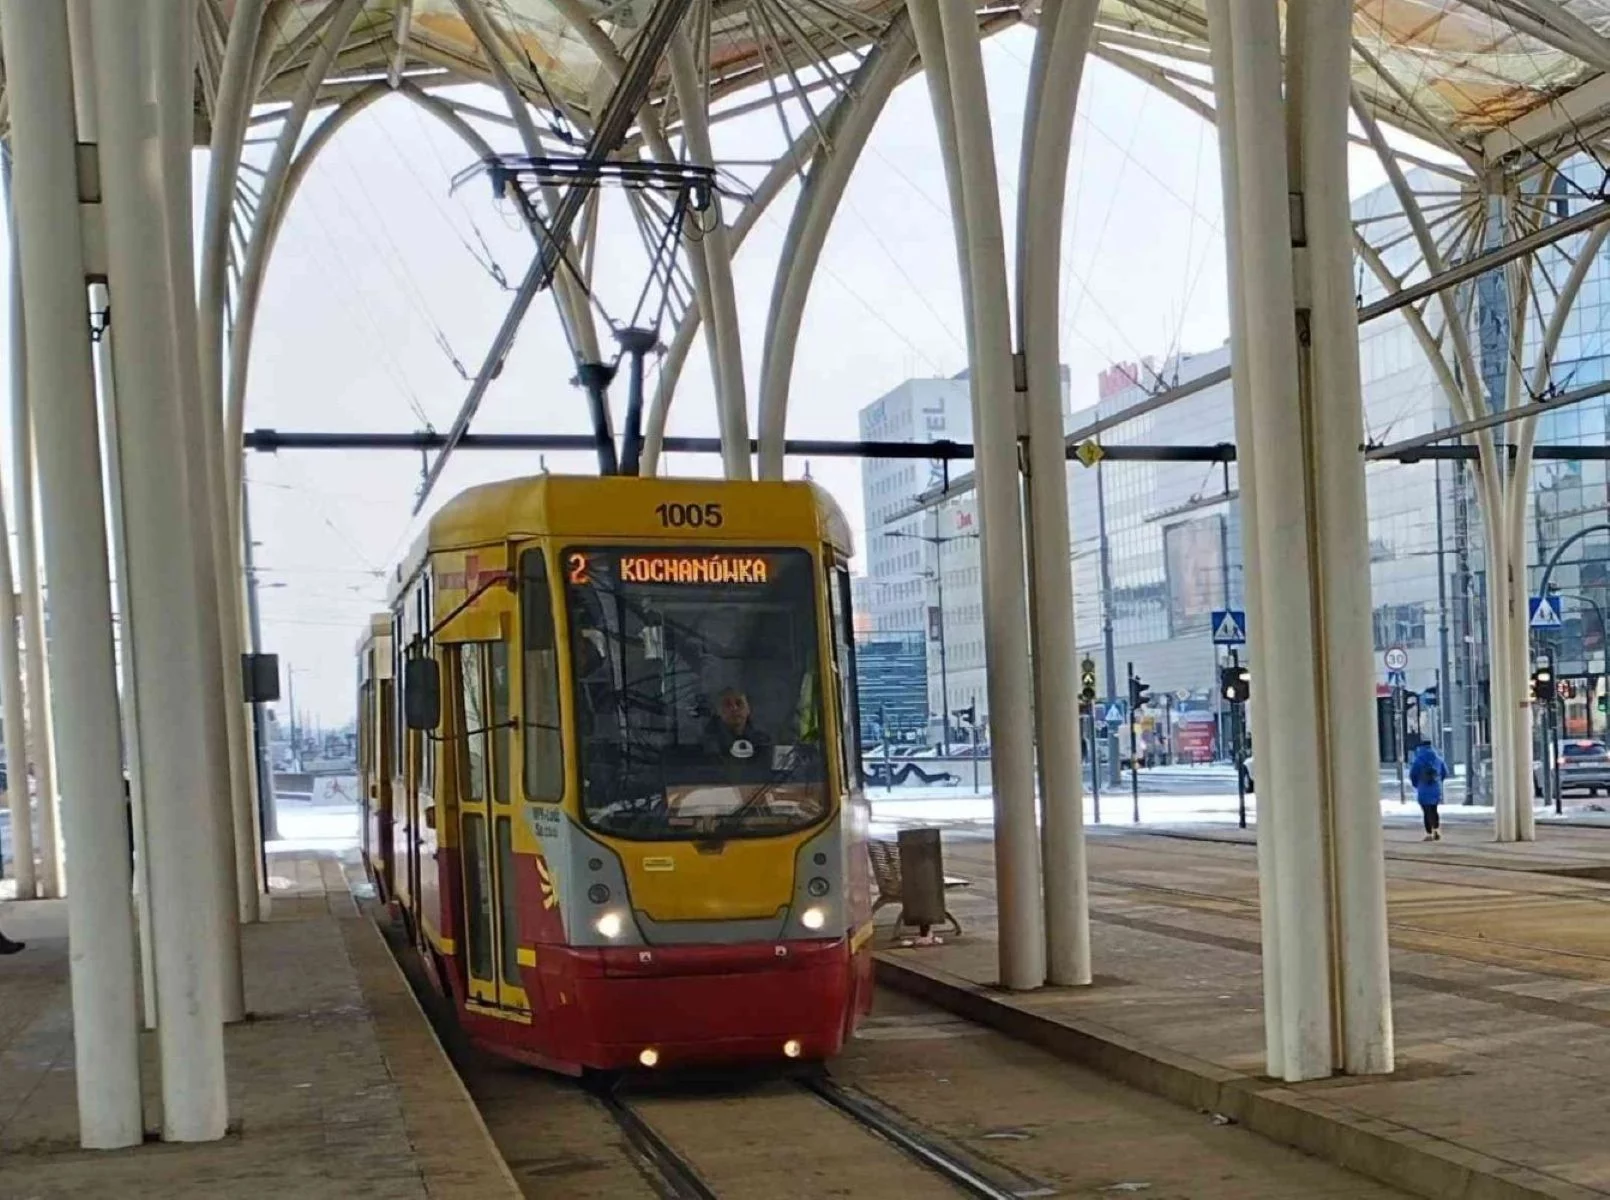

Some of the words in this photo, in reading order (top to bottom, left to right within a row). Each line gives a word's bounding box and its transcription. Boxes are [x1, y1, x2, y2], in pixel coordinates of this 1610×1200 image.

[655, 503, 723, 528] 1005
[569, 553, 589, 583] 2
[620, 554, 767, 582] KOCHANÓWKA
[1388, 654, 1404, 665] 30
